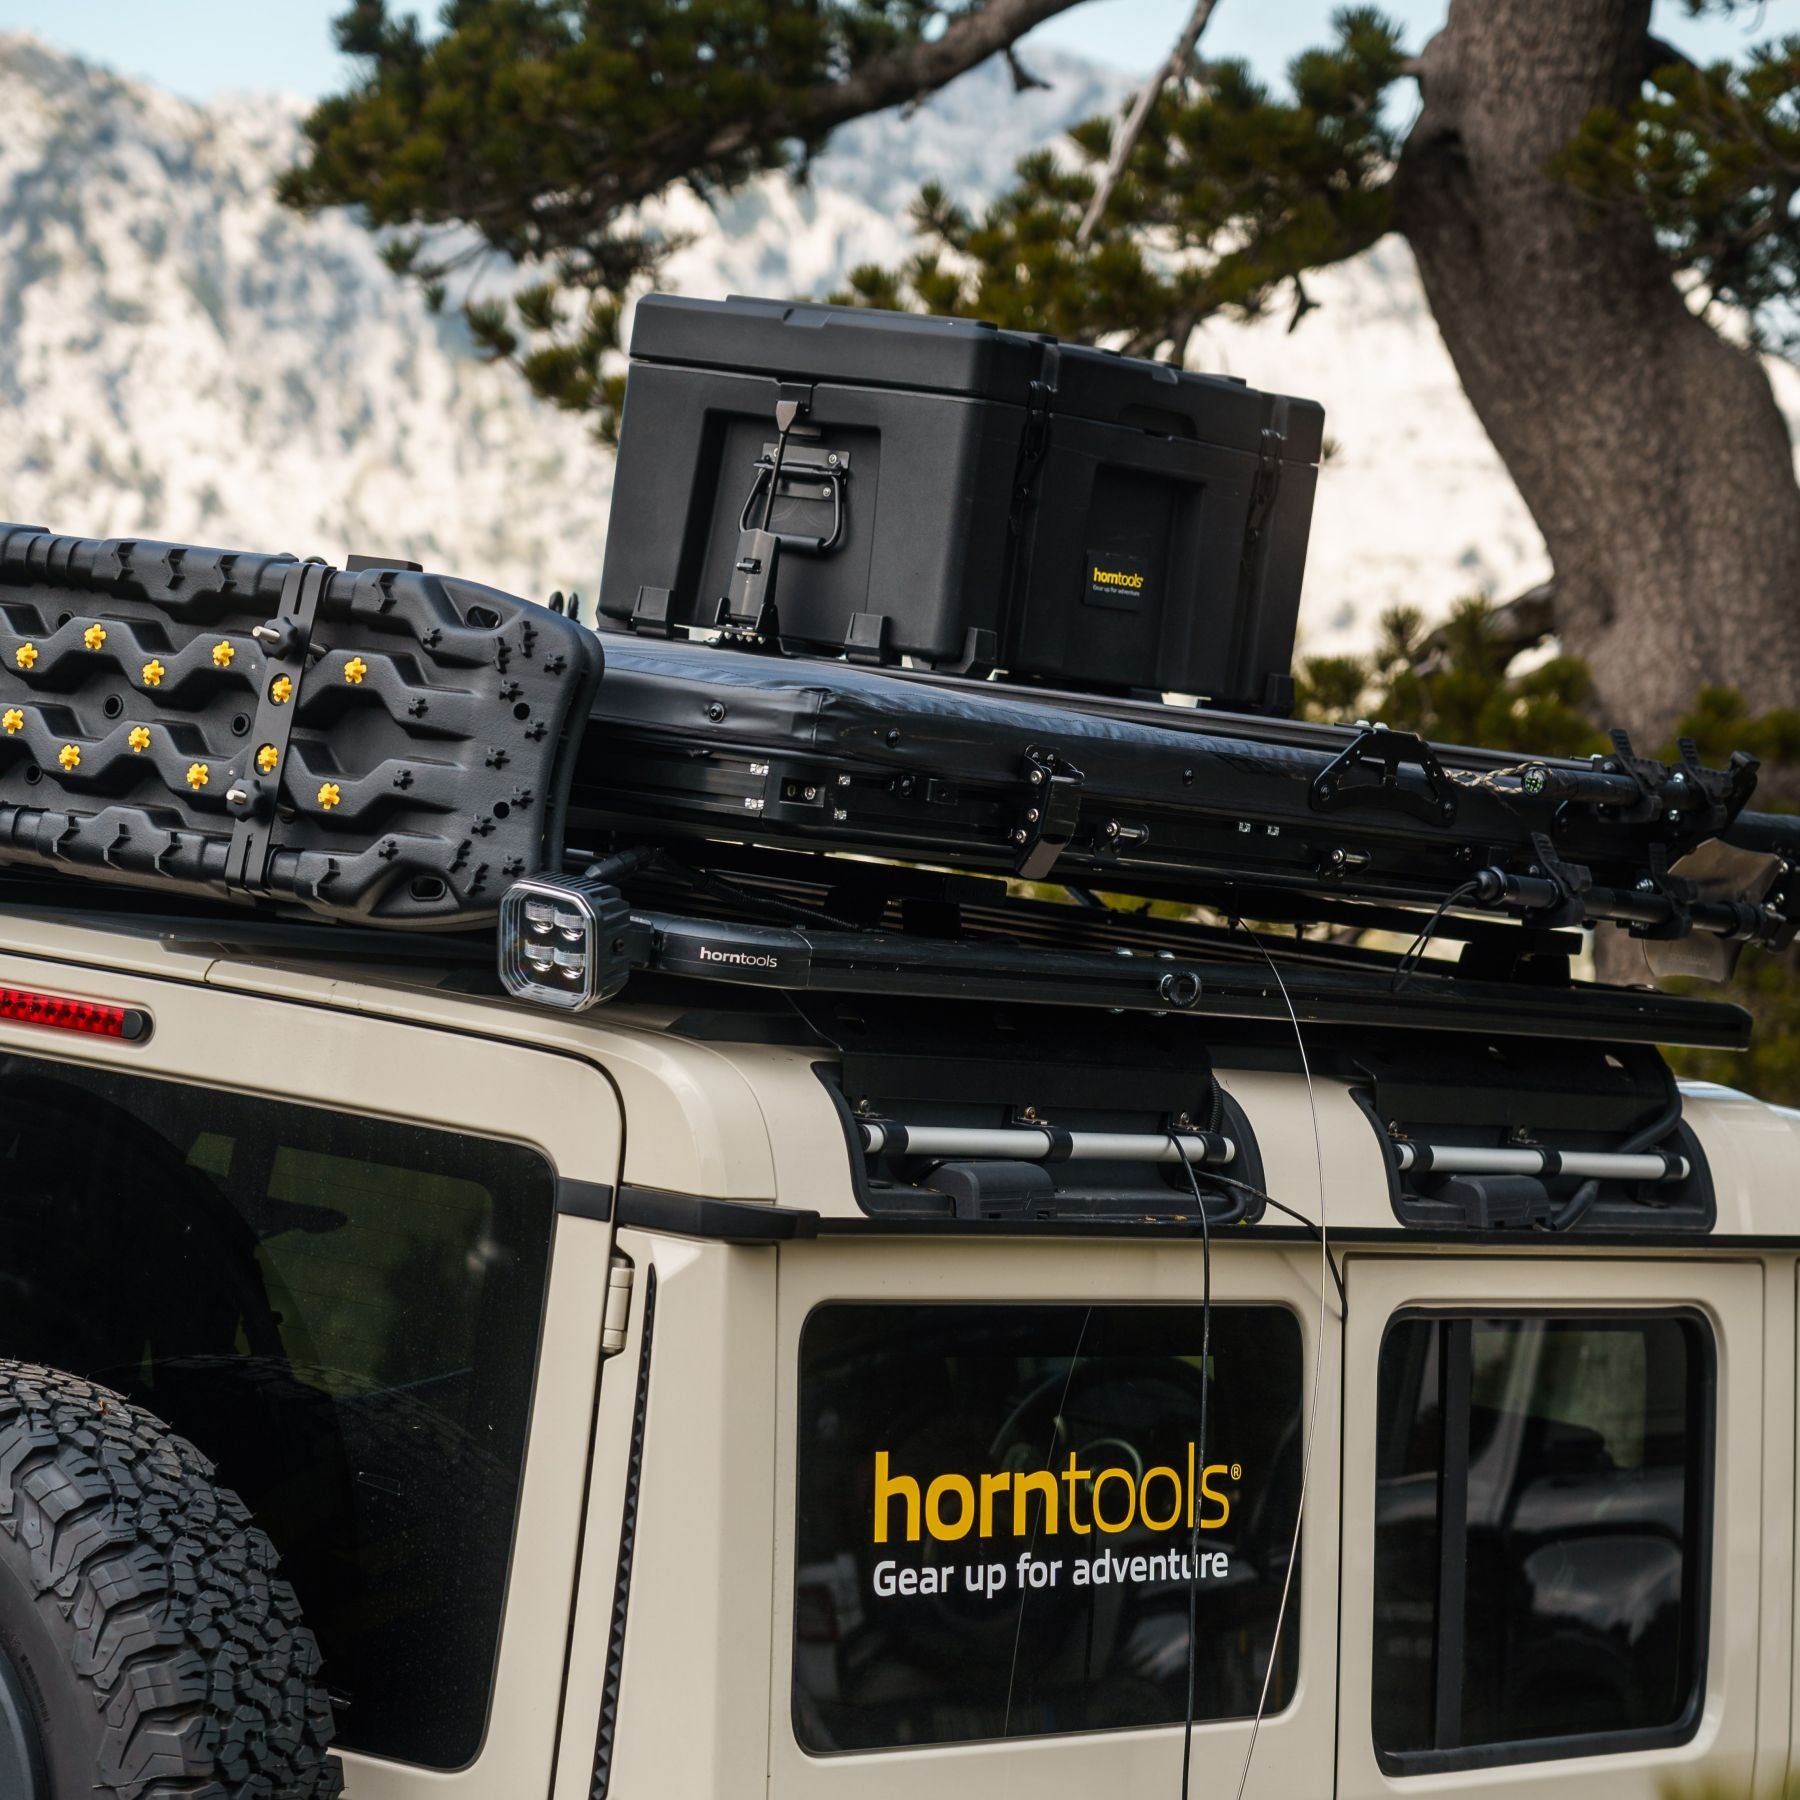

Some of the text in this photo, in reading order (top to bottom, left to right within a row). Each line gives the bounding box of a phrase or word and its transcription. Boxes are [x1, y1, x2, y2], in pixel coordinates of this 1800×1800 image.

[1093, 567, 1144, 588] horntools
[700, 946, 778, 968] horntools
[873, 1548, 1229, 1599] Gear up for adventure
